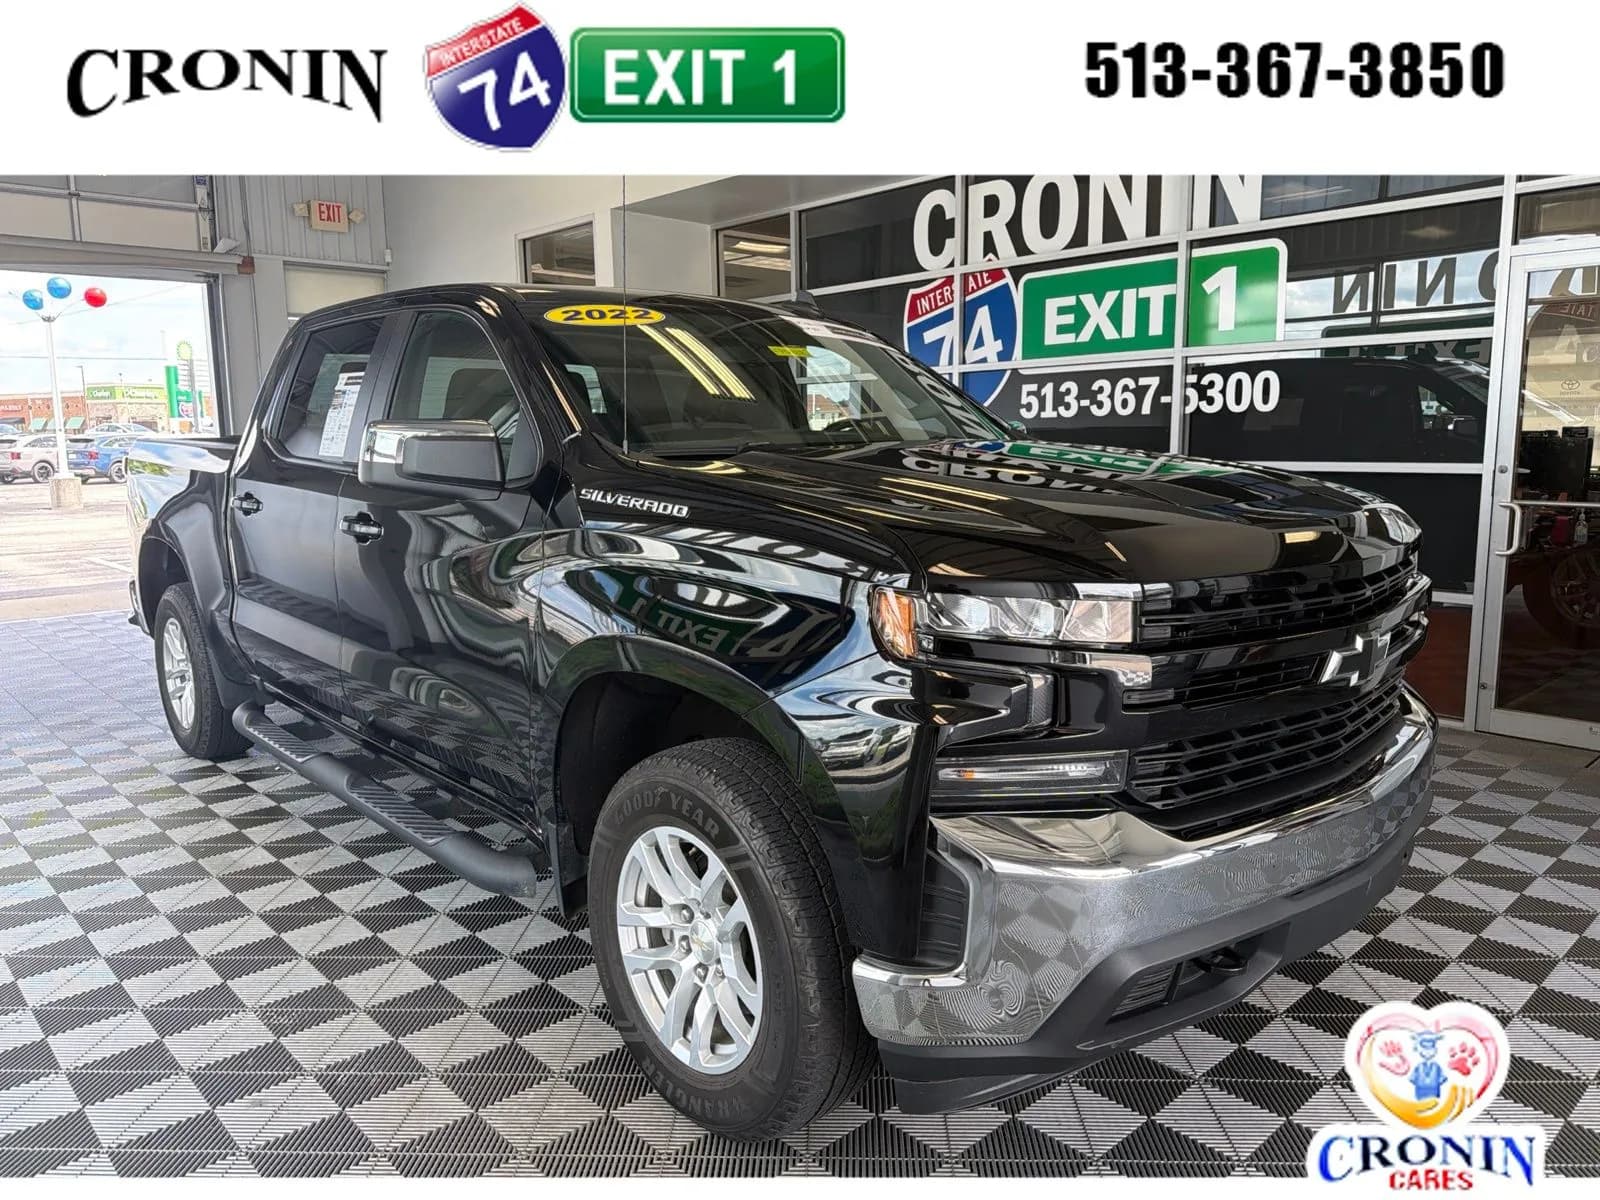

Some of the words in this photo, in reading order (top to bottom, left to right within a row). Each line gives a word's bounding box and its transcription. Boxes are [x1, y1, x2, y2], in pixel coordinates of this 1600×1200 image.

[318, 203, 341, 223] EXIT
[561, 309, 655, 321] 2022
[916, 272, 992, 316] INTERATE
[1044, 284, 1177, 346] EXIT
[1202, 266, 1237, 331] 1
[923, 304, 1004, 368] 74
[1019, 370, 1281, 419] 513-367-5300
[579, 488, 690, 518] SILVERADO
